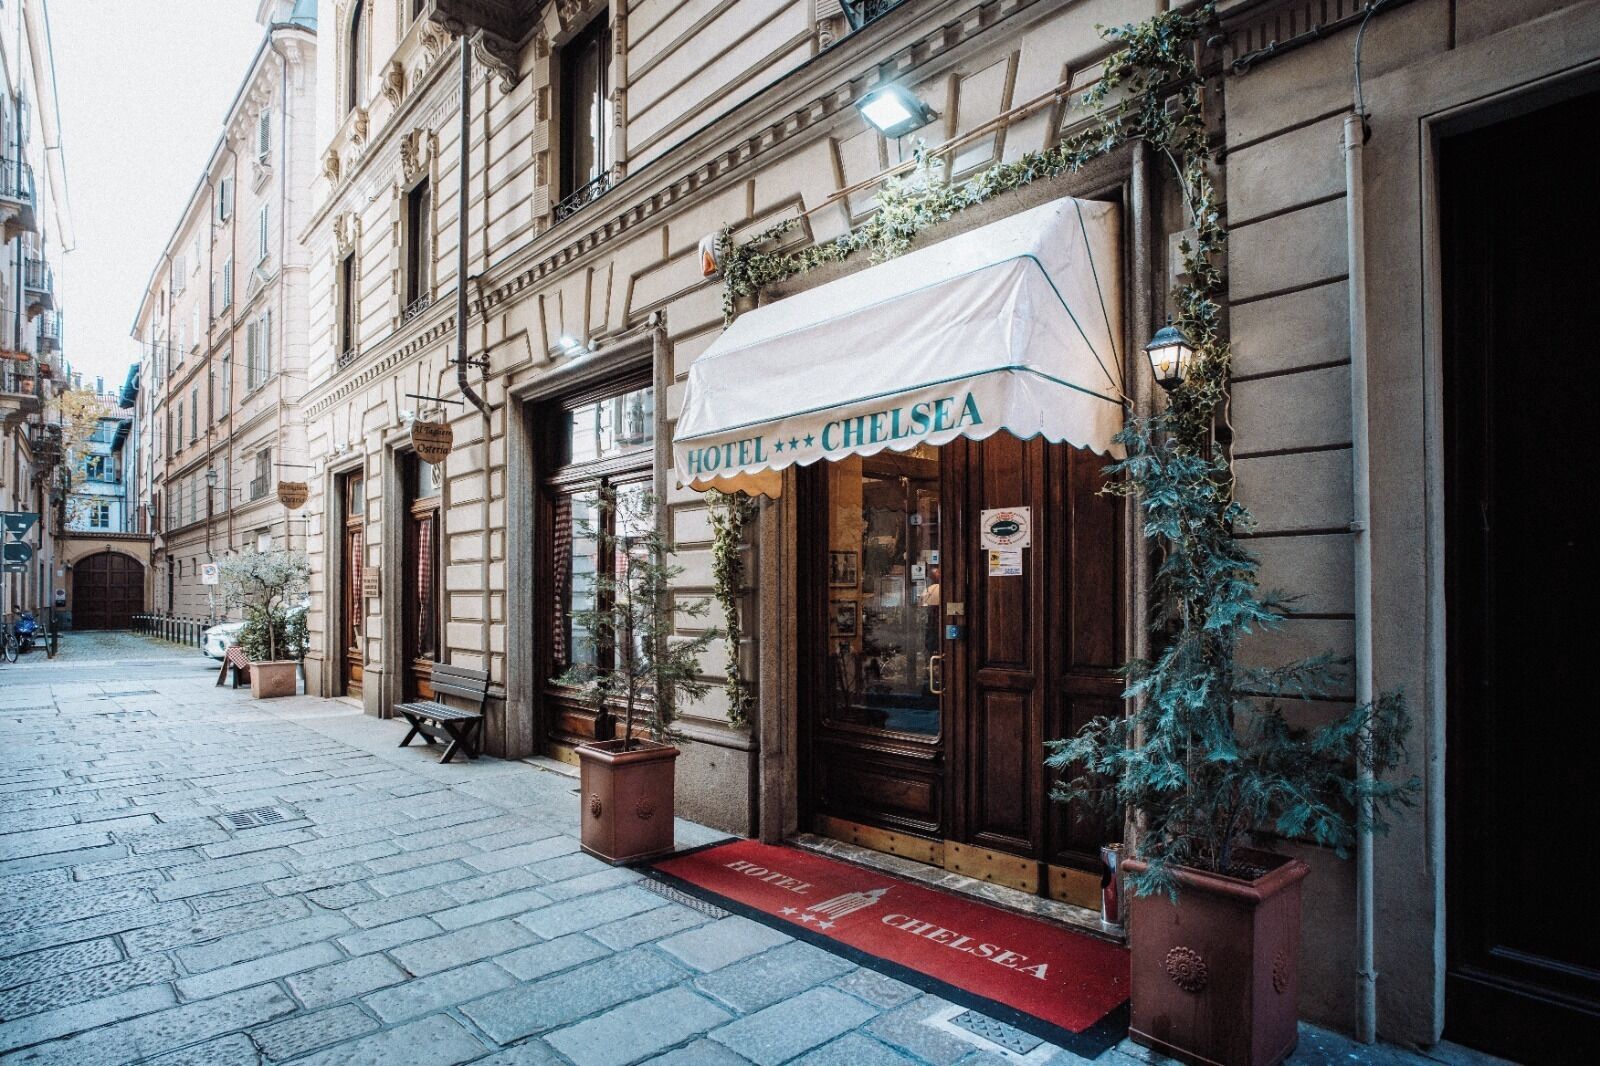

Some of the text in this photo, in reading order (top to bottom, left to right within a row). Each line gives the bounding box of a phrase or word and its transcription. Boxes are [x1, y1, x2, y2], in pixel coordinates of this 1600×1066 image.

[417, 443, 449, 454] Osteria
[688, 391, 983, 475] HOTEL CHELSEA
[723, 860, 1049, 980] HOTEL CHELSEA
